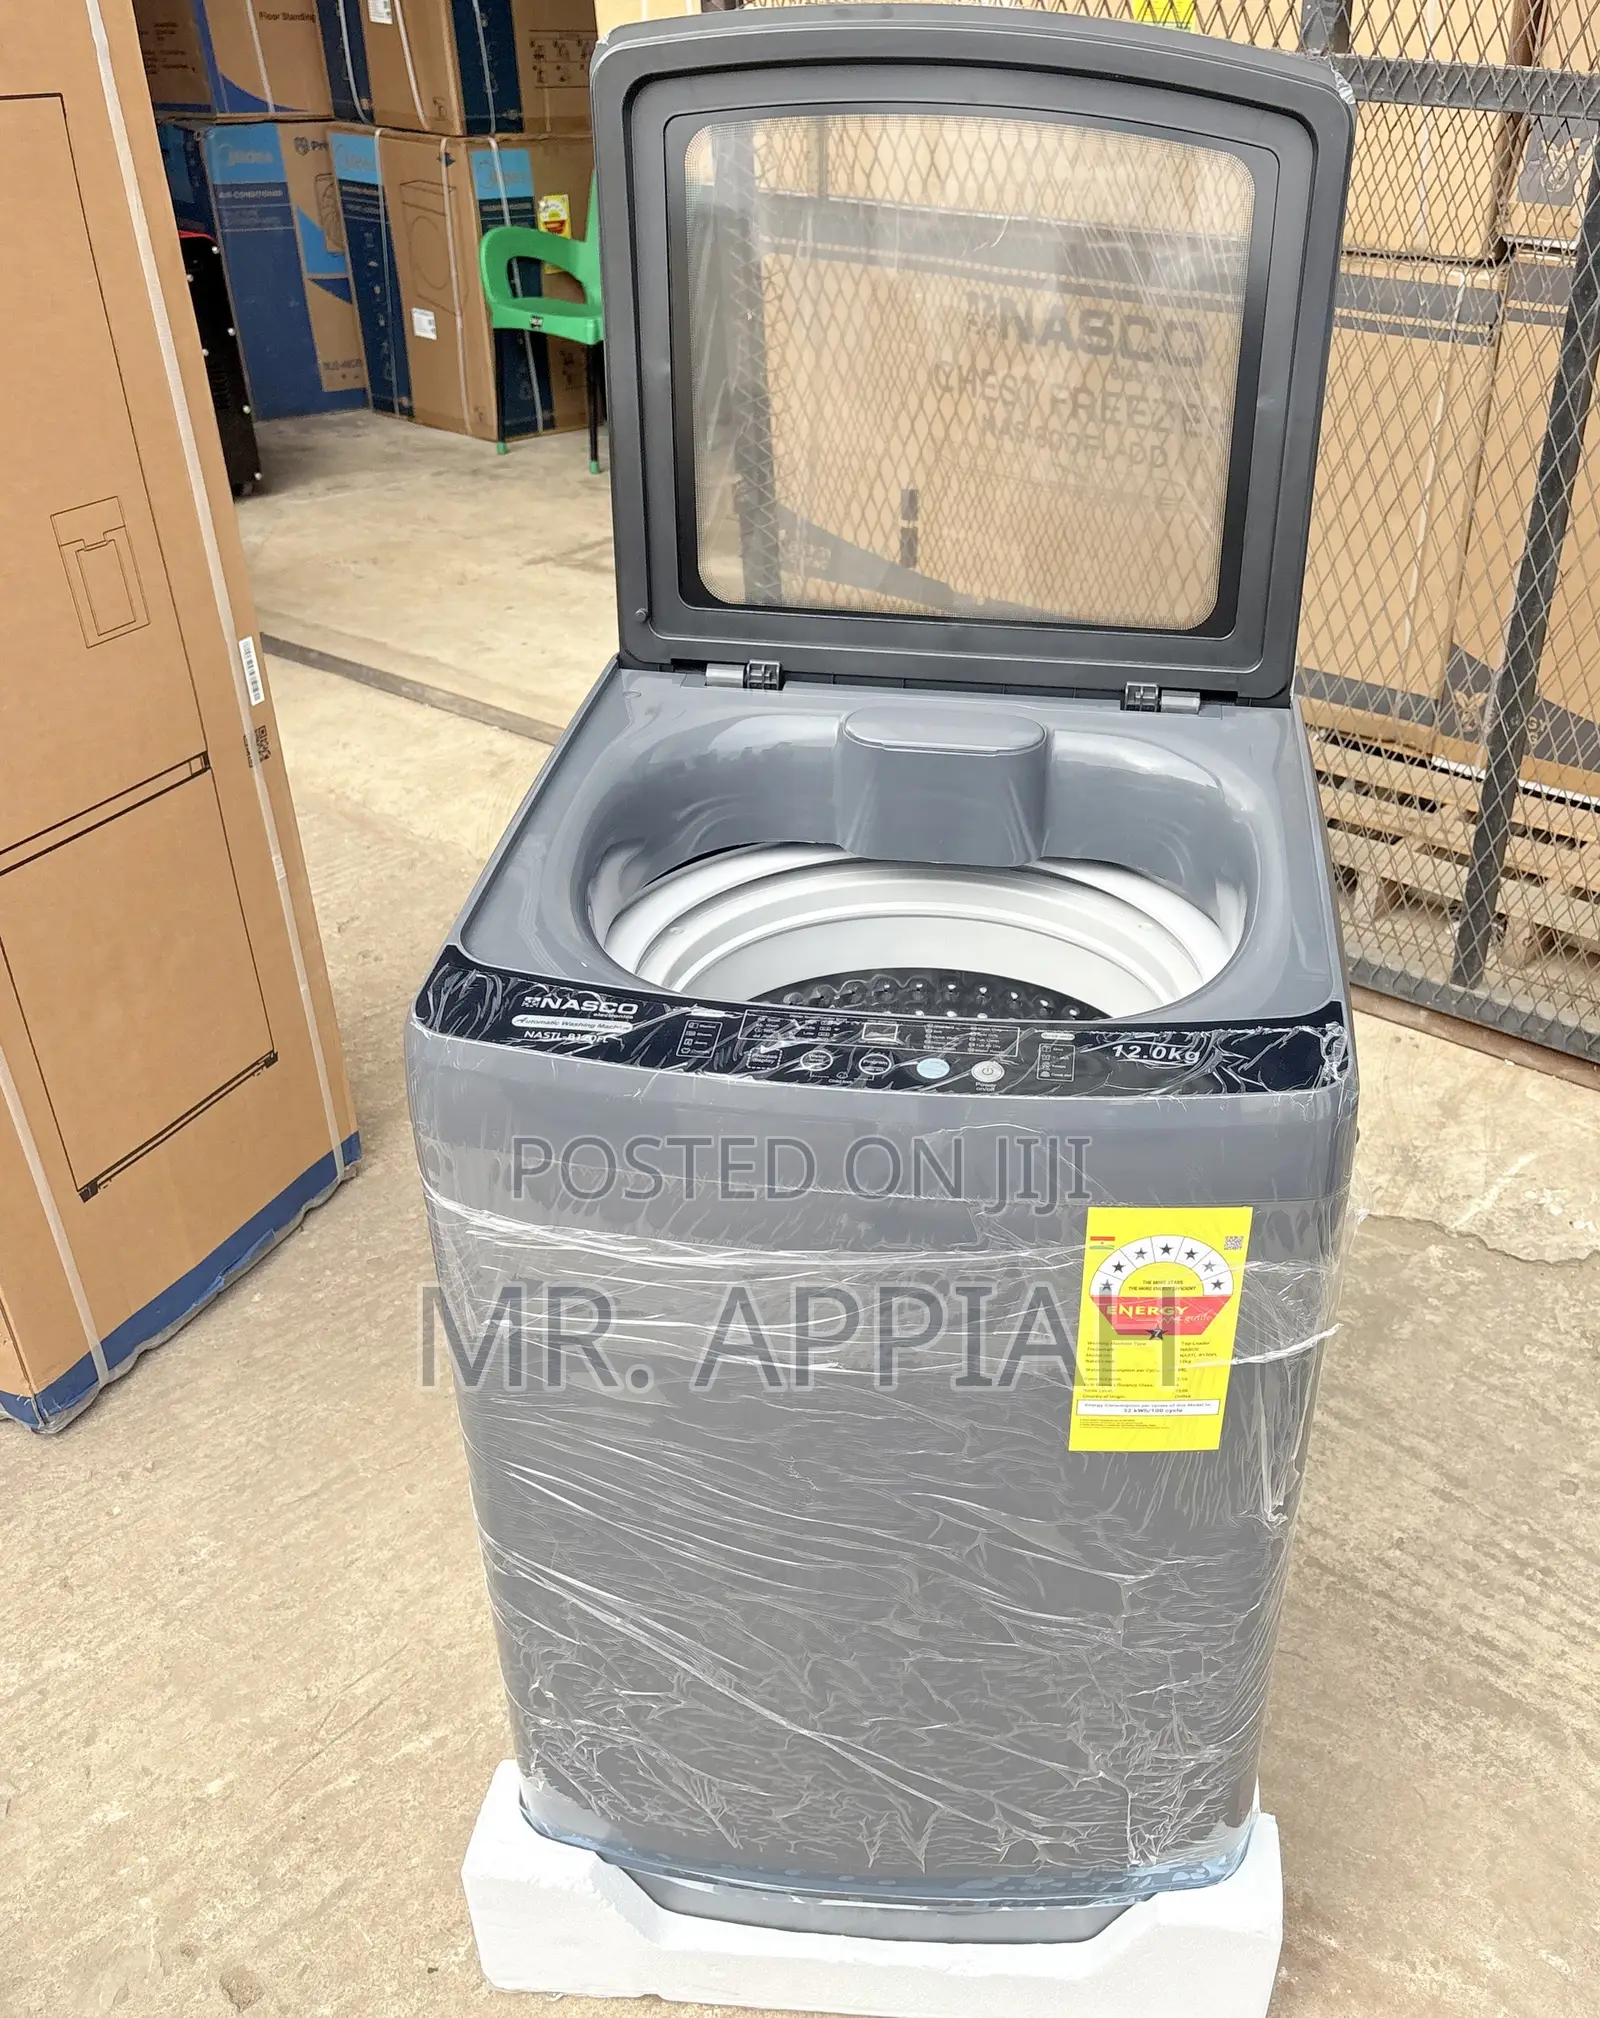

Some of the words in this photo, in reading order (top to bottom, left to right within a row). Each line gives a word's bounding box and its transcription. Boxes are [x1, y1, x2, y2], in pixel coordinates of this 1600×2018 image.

[259, 11, 281, 21] Floor
[998, 297, 1207, 367] NASCO
[540, 998, 639, 1015] NASCO
[516, 1017, 560, 1026] Automatic
[561, 1020, 596, 1029] Washing
[1112, 1044, 1201, 1064] 12.0kg
[1106, 1304, 1189, 1317] ENERGY
